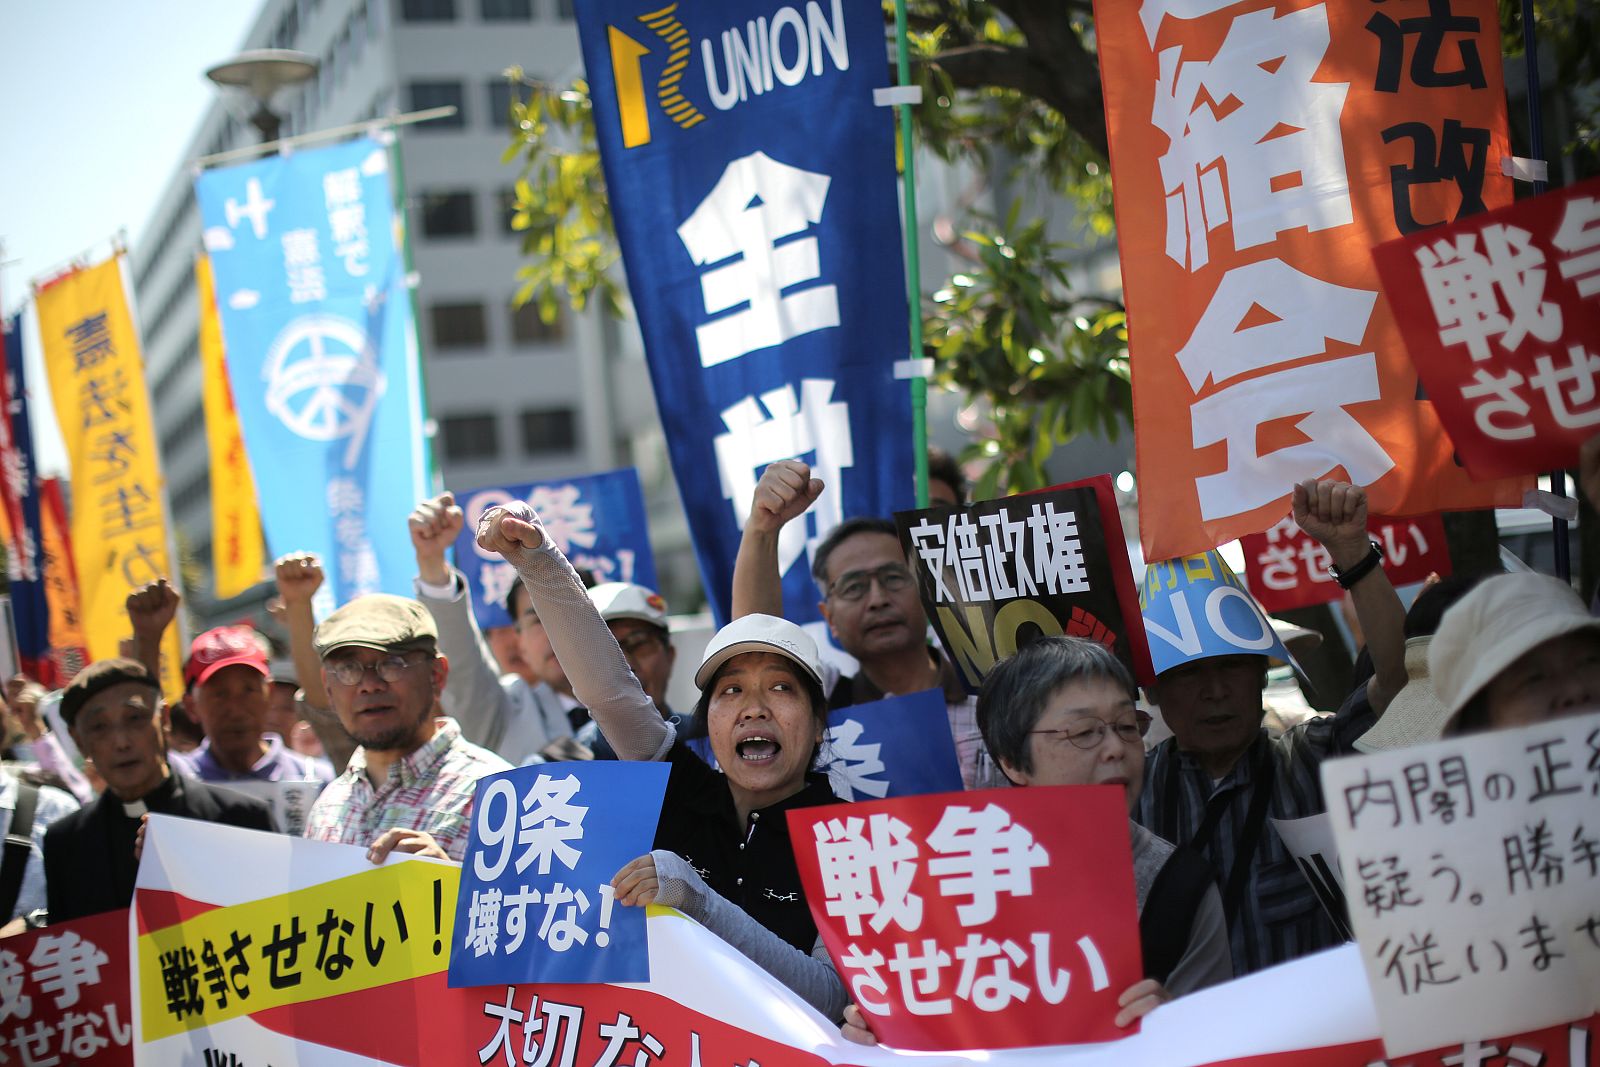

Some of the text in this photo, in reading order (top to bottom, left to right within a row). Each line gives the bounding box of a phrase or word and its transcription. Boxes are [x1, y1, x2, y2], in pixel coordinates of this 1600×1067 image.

[701, 0, 850, 110] UNION
[1139, 0, 1396, 520] 絡会
[909, 502, 1090, 603] 安倍政権
[473, 773, 590, 882] 9条
[813, 803, 1049, 936] 戦争
[158, 879, 442, 1022] 戦争させない!
[464, 882, 616, 958] 壊すな!
[841, 932, 1110, 1016] させない
